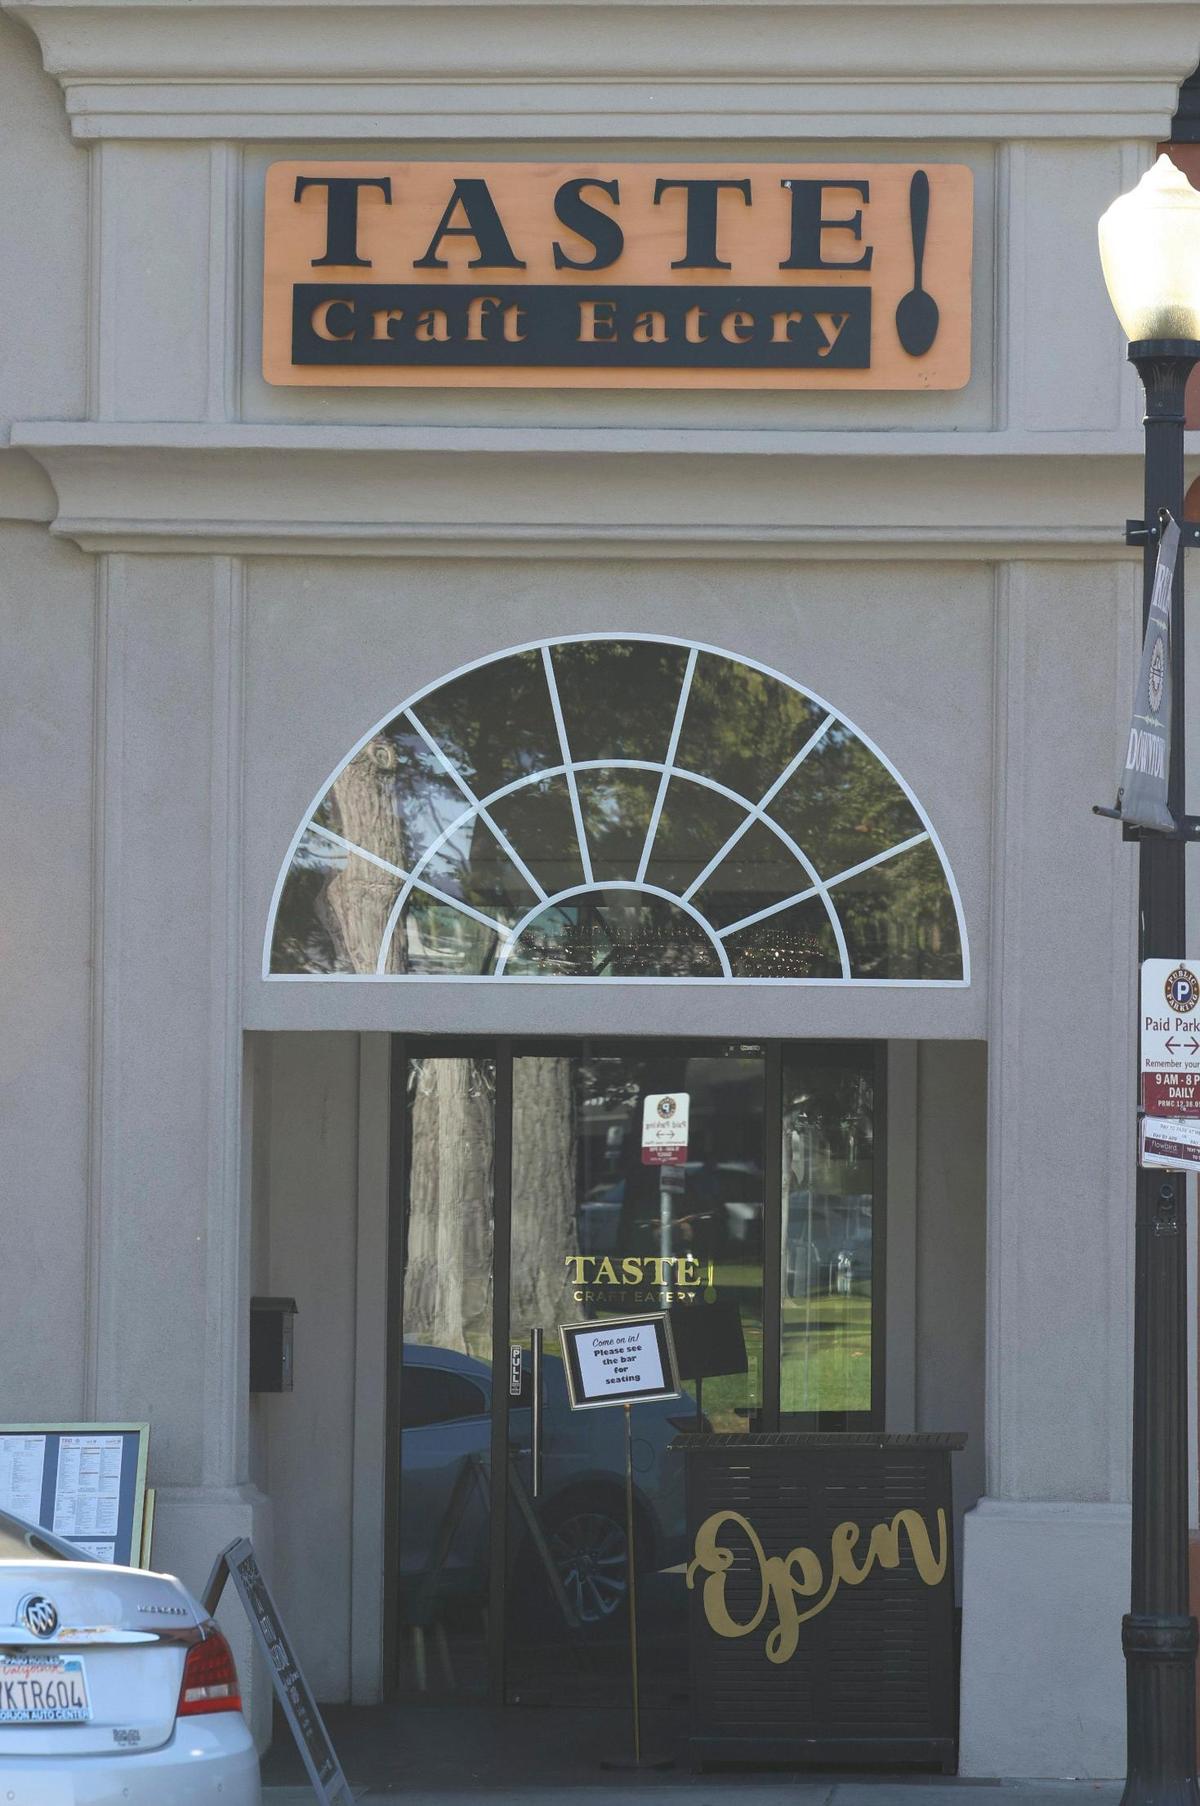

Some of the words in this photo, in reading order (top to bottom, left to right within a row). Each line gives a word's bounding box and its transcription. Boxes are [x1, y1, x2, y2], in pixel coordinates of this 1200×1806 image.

[311, 296, 528, 344] Craft
[576, 300, 852, 358] Eatery
[1168, 970, 1197, 985] PUBLIC
[1177, 981, 1190, 1001] P
[1166, 993, 1198, 1012] PARKING
[1145, 1016, 1170, 1031] Paid
[1145, 1059, 1182, 1068] Remember
[1184, 1061, 1200, 1070] your
[1155, 1073, 1162, 1085] 9
[1163, 1073, 1179, 1085] AM
[1186, 1074, 1192, 1086] 8
[1169, 1087, 1195, 1098] DAILY
[573, 1291, 627, 1301] CRAFT
[634, 1291, 696, 1302] EATERY
[592, 1338, 614, 1347] Come
[628, 1333, 640, 1342] in!
[594, 1348, 625, 1357] Please
[626, 1345, 643, 1353] see
[512, 1349, 520, 1383] PULL
[621, 1355, 637, 1363] bar
[614, 1366, 628, 1374] for
[605, 1374, 641, 1384] seating
[686, 1508, 948, 1664] Open
[0, 1680, 83, 1709] KTR604
